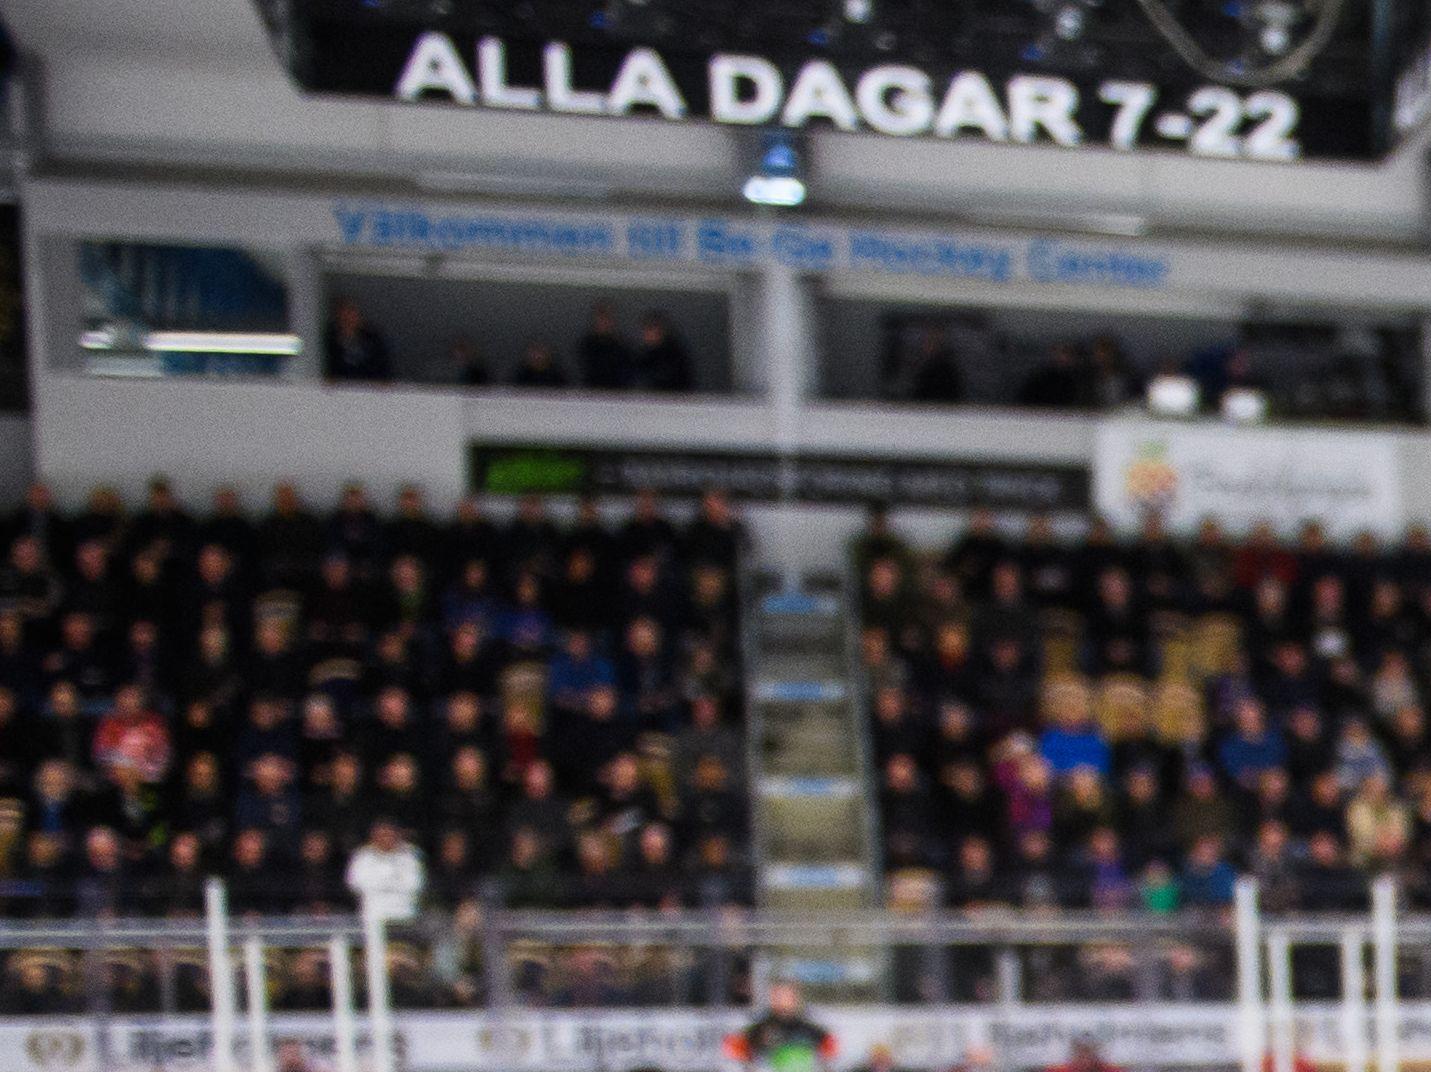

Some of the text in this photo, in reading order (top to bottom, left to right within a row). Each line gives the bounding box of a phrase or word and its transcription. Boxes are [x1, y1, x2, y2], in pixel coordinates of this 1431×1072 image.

[399, 32, 1300, 160] ALLA DAGAR 7-22
